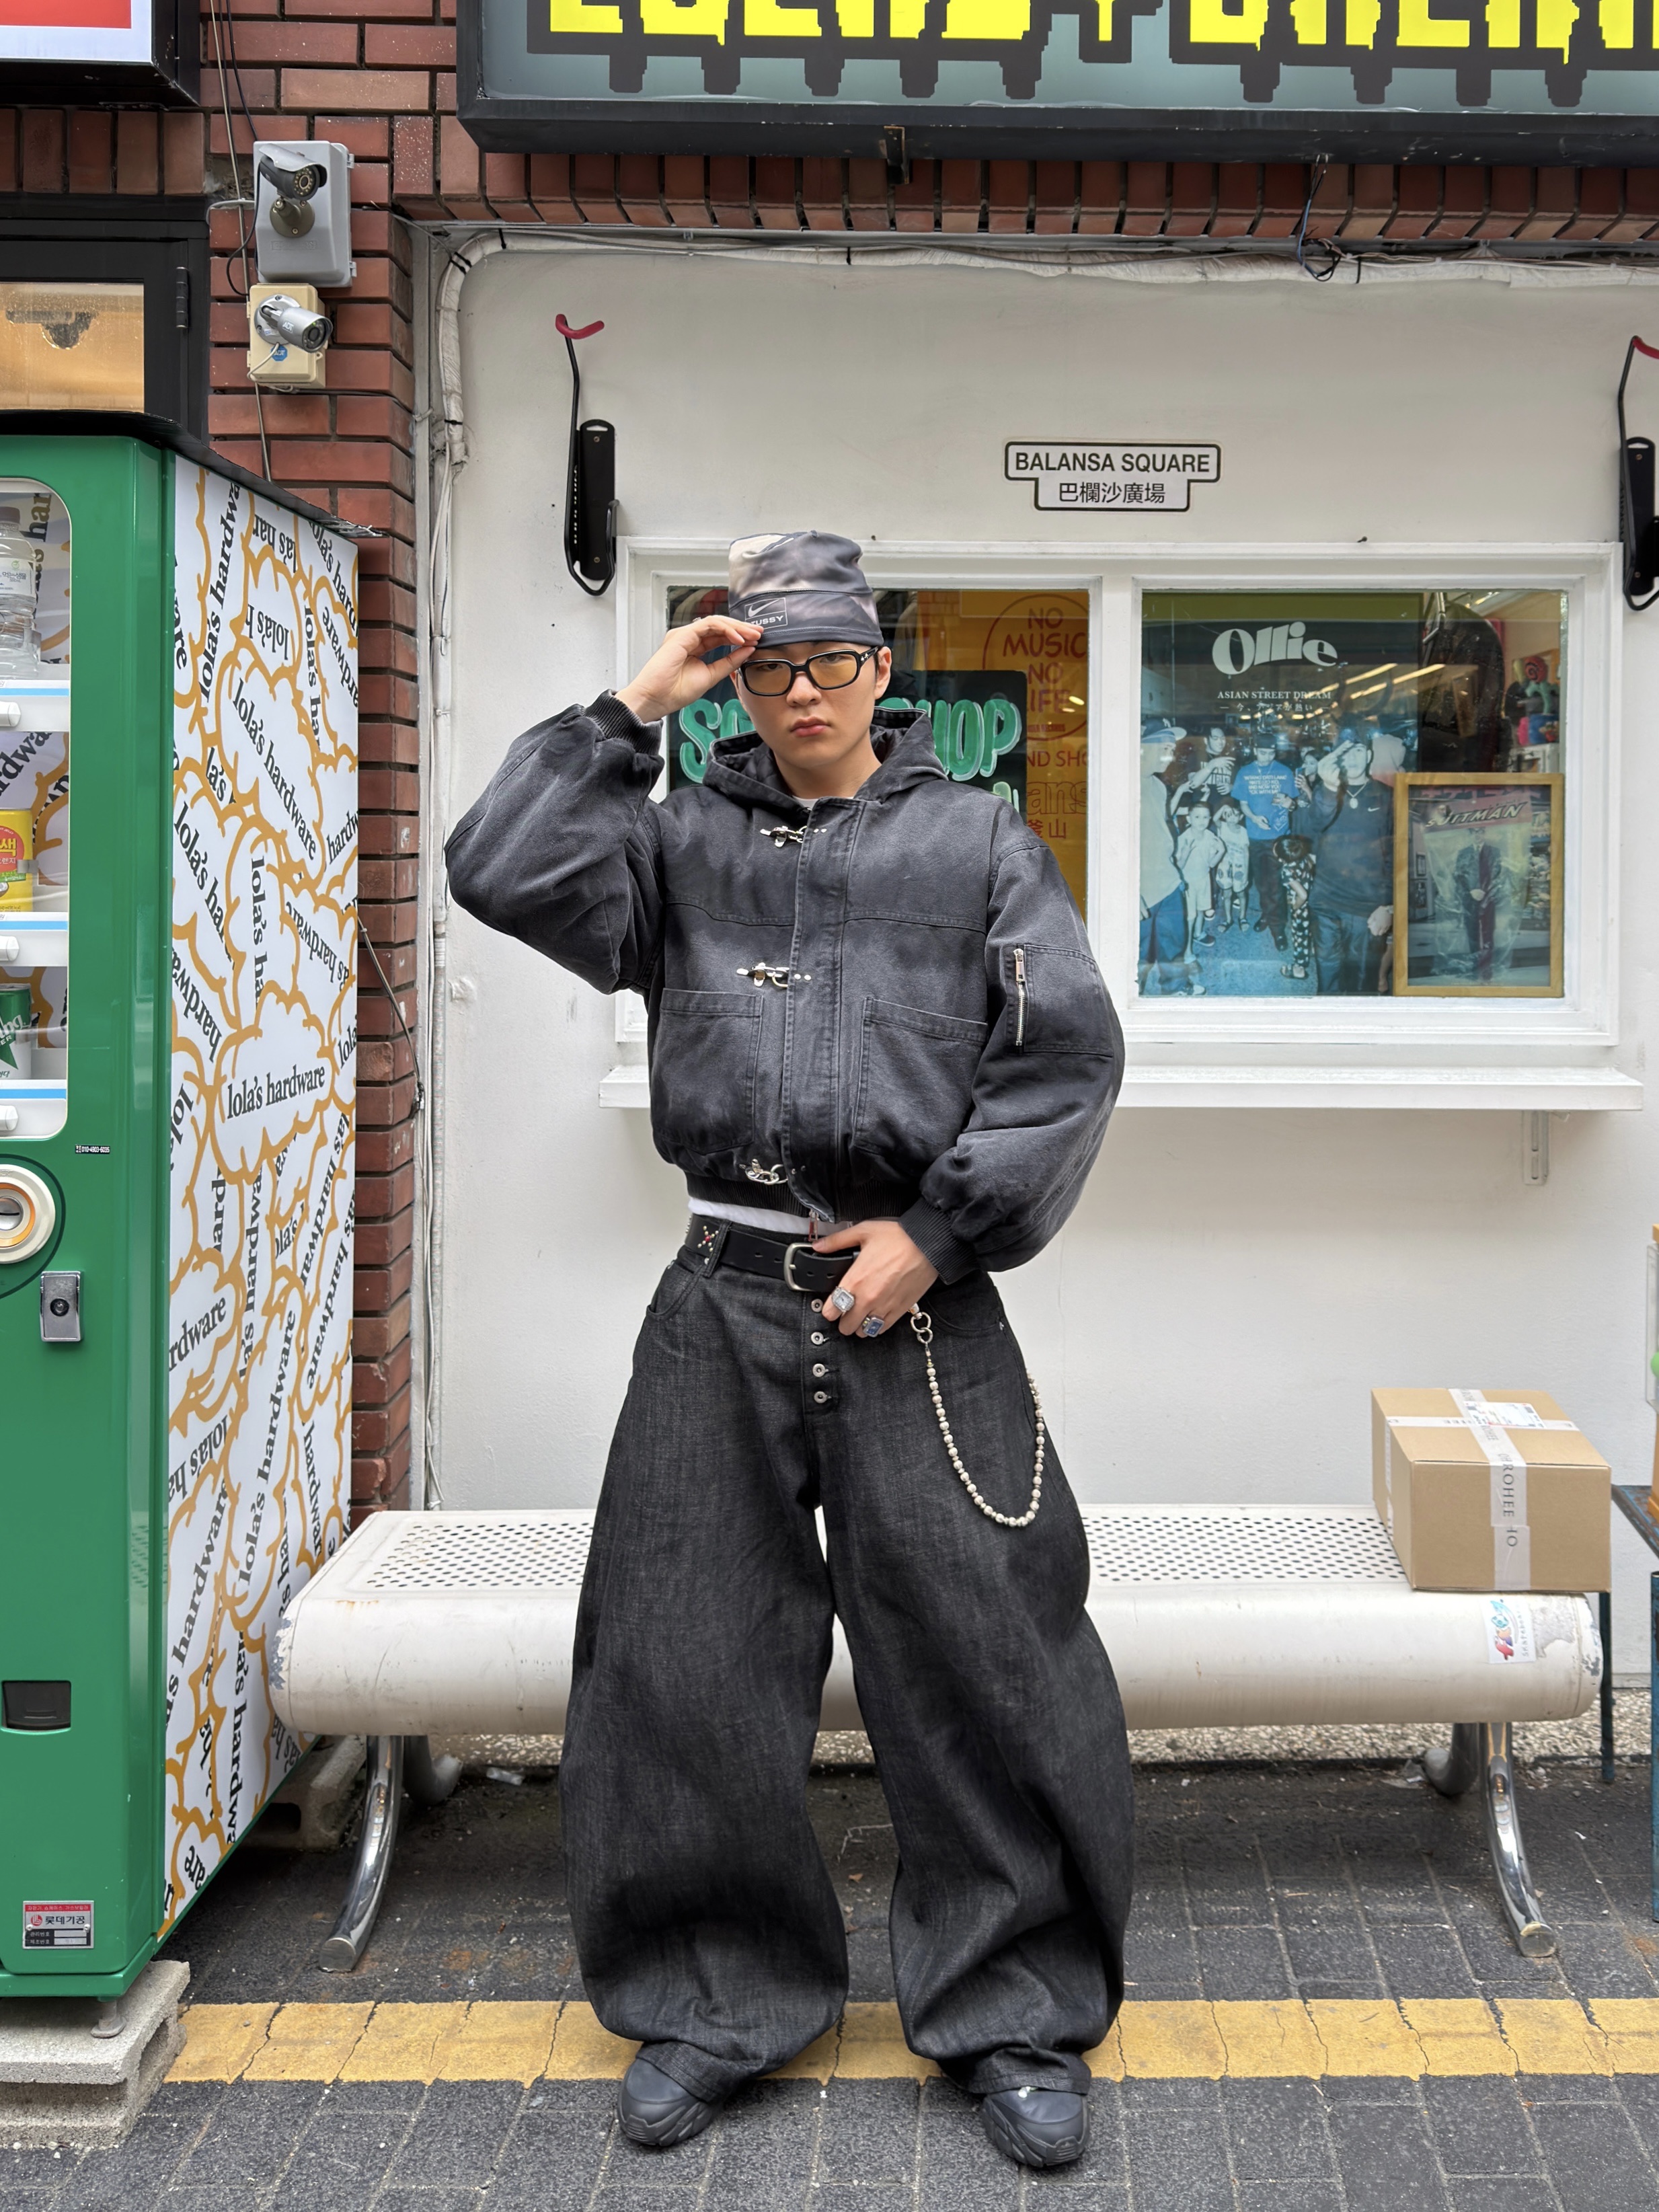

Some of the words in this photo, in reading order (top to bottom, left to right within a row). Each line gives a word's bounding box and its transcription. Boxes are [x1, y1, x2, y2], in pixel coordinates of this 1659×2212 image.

[282, 321, 294, 332] ADT
[1015, 452, 1116, 471] BALANSA
[1121, 453, 1210, 473] SQUARE
[1059, 482, 1166, 504] 巴欄沙廣場
[750, 615, 783, 625] TUSSY
[1028, 607, 1064, 630] NO
[1003, 632, 1088, 659] MUSIC
[1212, 621, 1338, 675] Ollie
[1027, 662, 1064, 685] NO
[1027, 689, 1071, 713] IFE
[1217, 691, 1249, 699] ASIAN
[1251, 691, 1290, 699] STREET
[1293, 691, 1332, 699] DREAM
[233, 678, 265, 756] lola's
[264, 740, 316, 861] hardware
[1426, 802, 1528, 827] SUITMAN
[173, 802, 208, 890] lola's
[251, 856, 266, 946] lola's
[227, 1075, 263, 1119] lola's
[266, 1064, 325, 1106] hardware
[307, 1238, 348, 1389] hardware
[239, 1491, 266, 1586] lola's
[258, 1311, 295, 1484] hardware
[45, 1915, 85, 1925] 롯데기공
